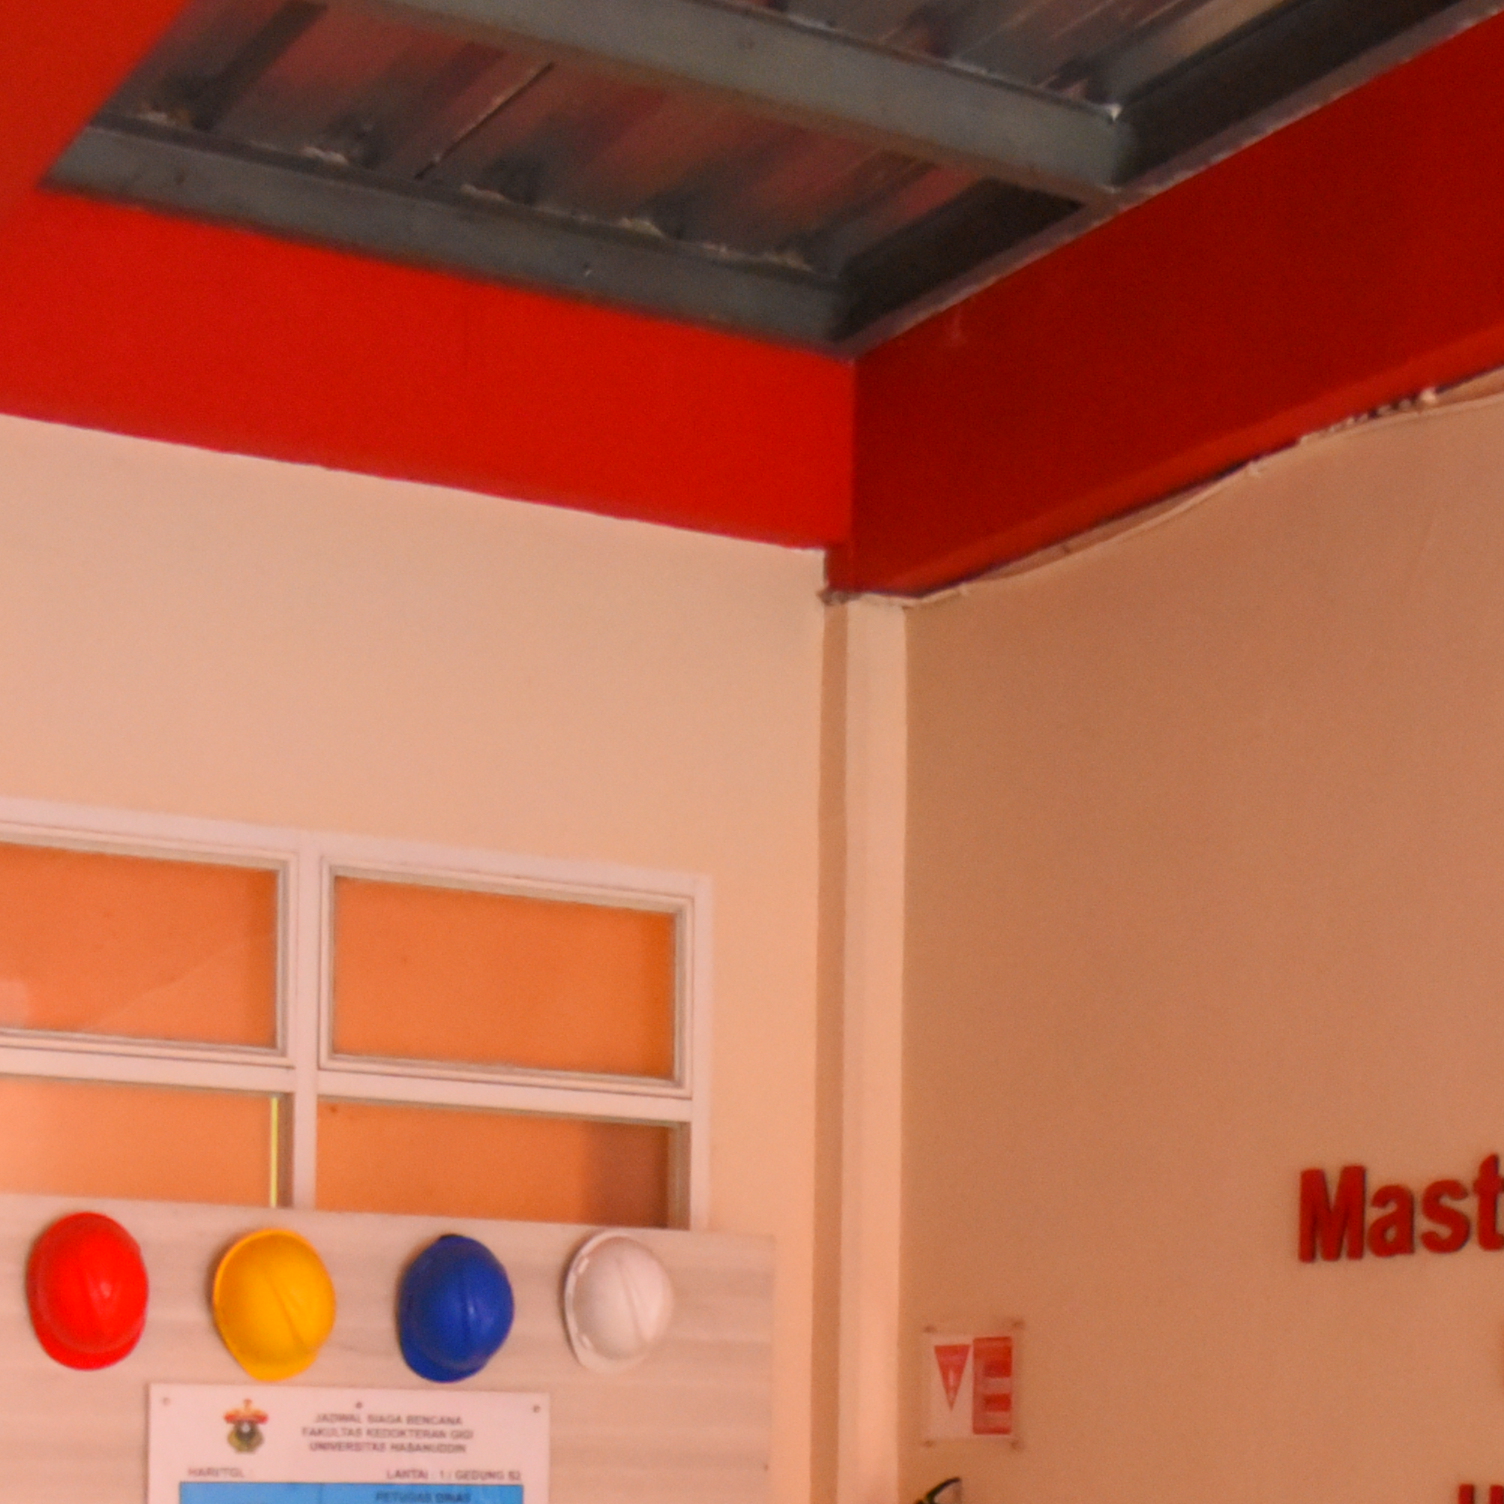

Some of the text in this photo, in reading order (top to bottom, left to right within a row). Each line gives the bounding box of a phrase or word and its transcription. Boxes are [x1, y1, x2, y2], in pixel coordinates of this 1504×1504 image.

[367, 1414, 403, 1425] SIAGA
[406, 1414, 464, 1426] BENCANA
[301, 1426, 475, 1440] FAKULTAS KEDOKTERAN GIGI
[309, 1441, 468, 1454] UNIVERSITAS HASANUDDIN
[386, 1469, 429, 1481] LANTAI
[454, 1469, 505, 1481] GEDUNG
